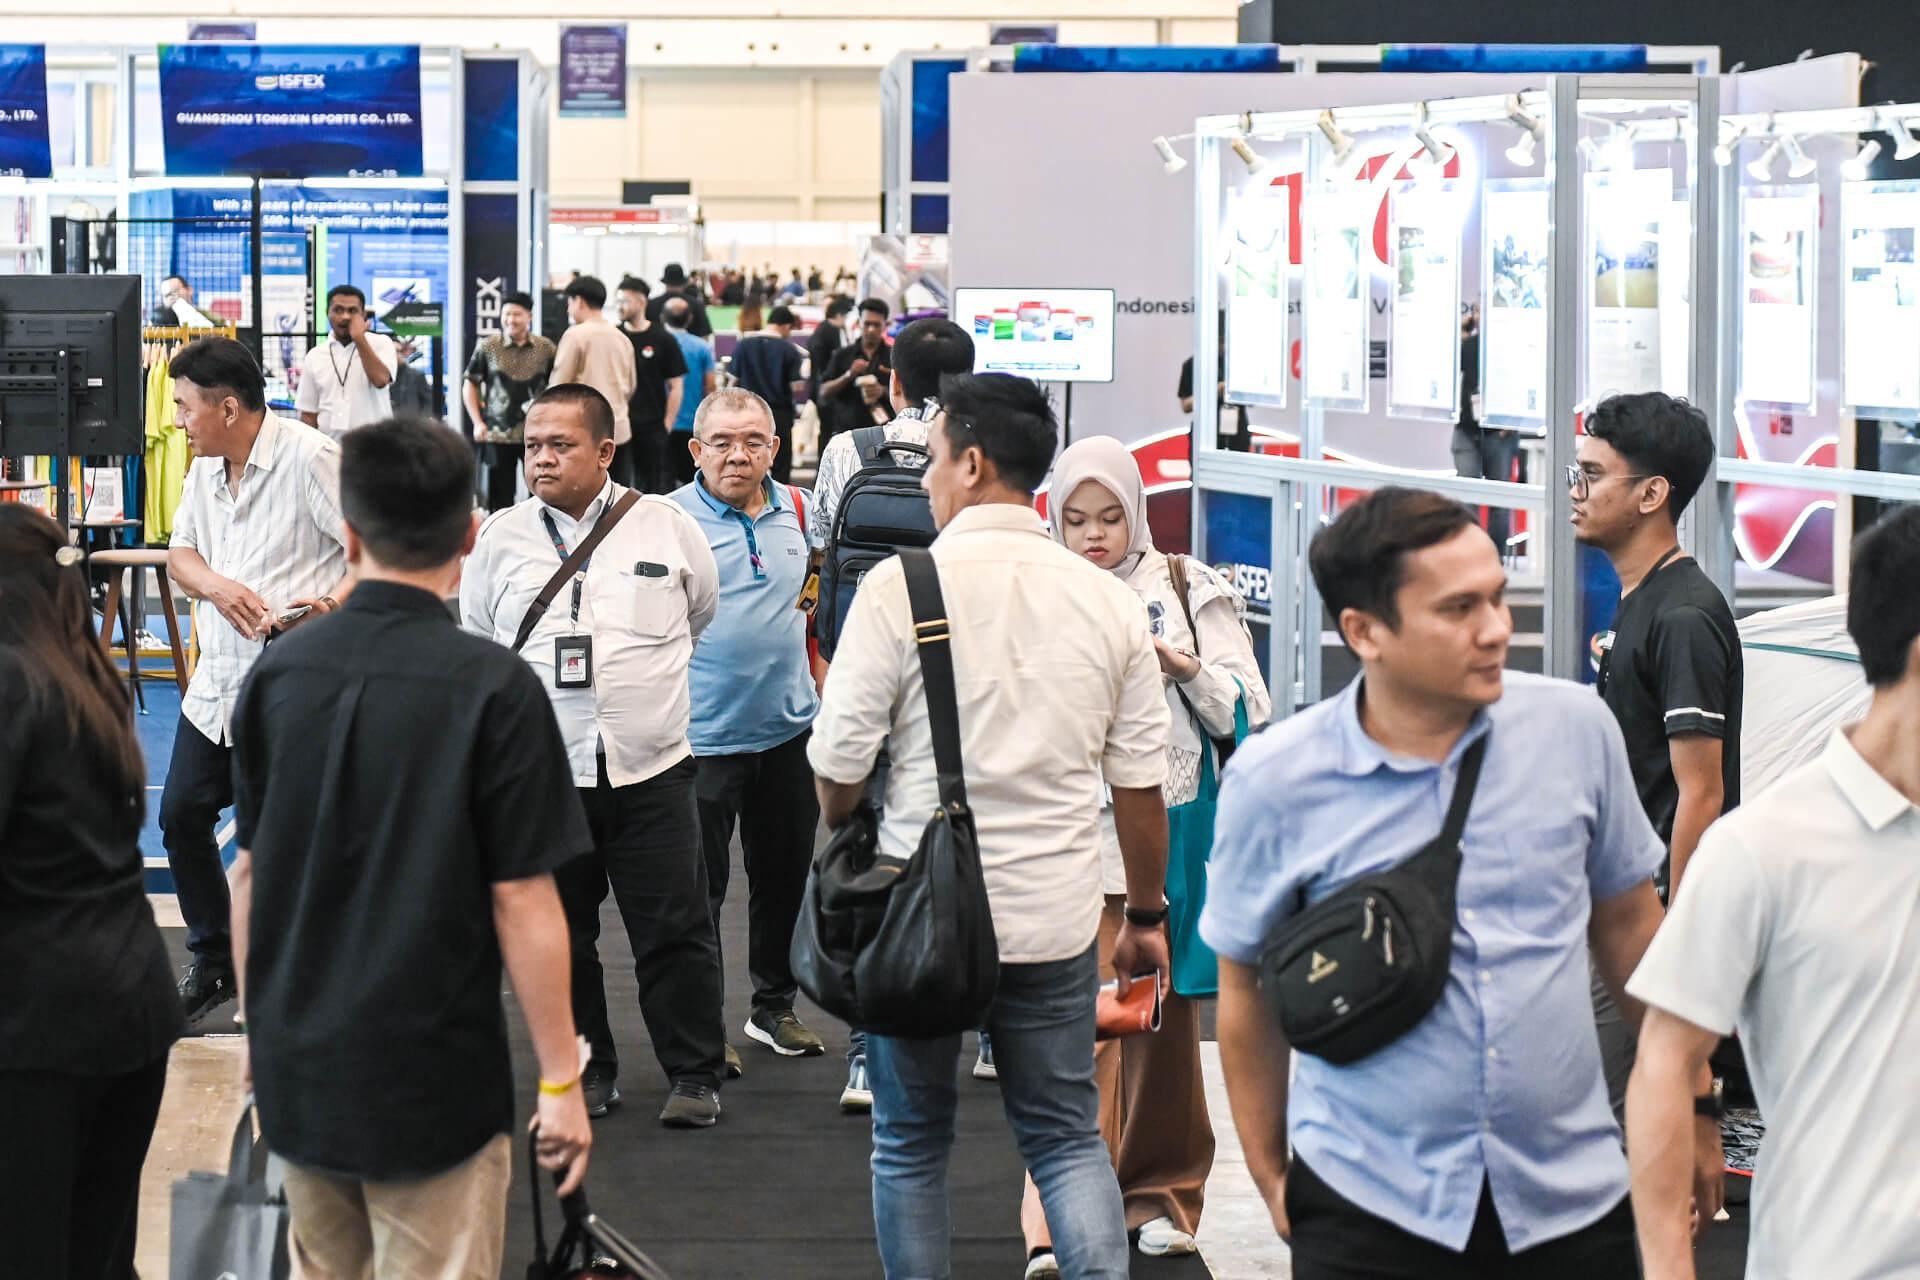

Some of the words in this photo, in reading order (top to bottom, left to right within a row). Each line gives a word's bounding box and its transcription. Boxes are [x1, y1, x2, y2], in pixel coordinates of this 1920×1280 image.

[280, 74, 325, 89] ISFEX
[14, 110, 38, 120] LTD.
[177, 112, 253, 124] GUANGZHOU
[255, 113, 310, 125] TONGXIN
[312, 113, 358, 125] SPORTS
[359, 113, 385, 126] CO.,
[387, 112, 412, 125] LTD.
[213, 199, 240, 212] With
[291, 199, 304, 212] of
[374, 203, 391, 213] we
[393, 200, 421, 213] have
[361, 216, 408, 230] projects
[476, 277, 501, 335] FEX
[1117, 298, 1195, 314] ndonesi
